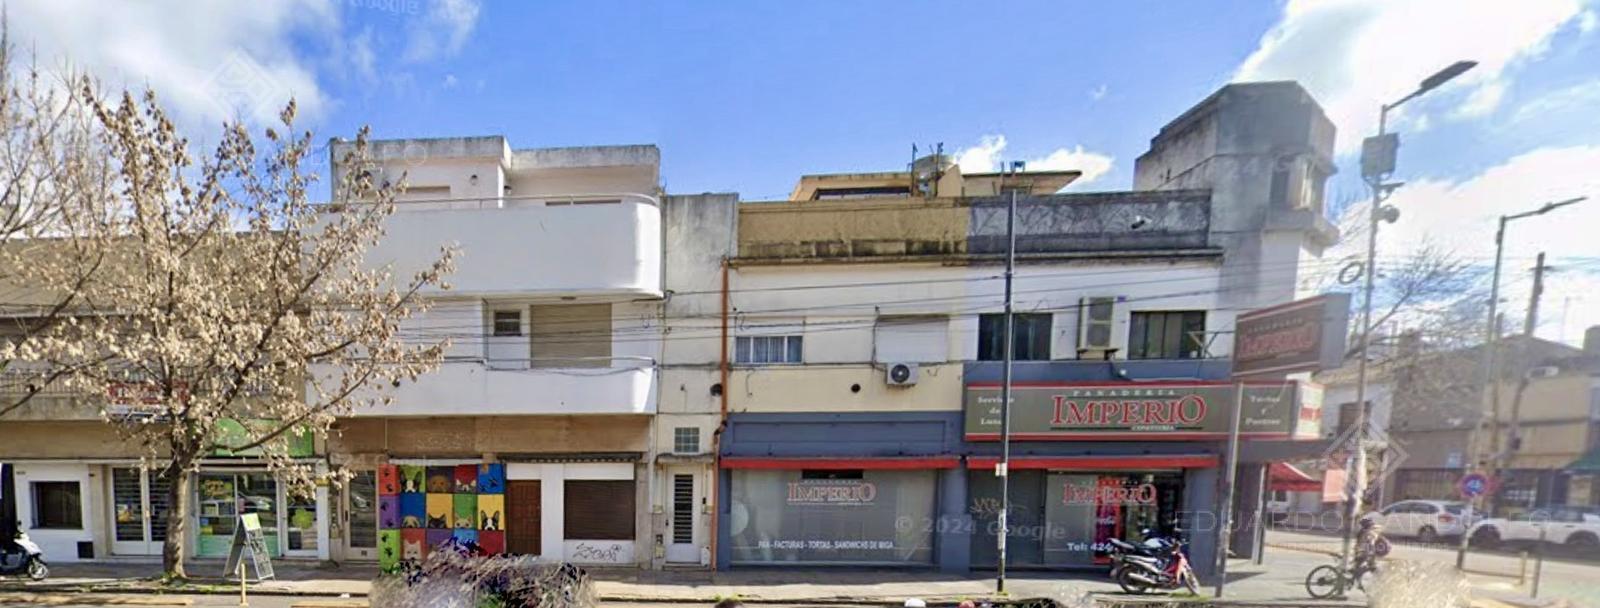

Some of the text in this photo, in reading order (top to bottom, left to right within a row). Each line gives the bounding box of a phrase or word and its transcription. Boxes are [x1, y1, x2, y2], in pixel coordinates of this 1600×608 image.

[1051, 394, 1207, 424] IMPERIO
[787, 482, 877, 502] IMPERIO
[1063, 484, 1157, 504] IMPERIO
